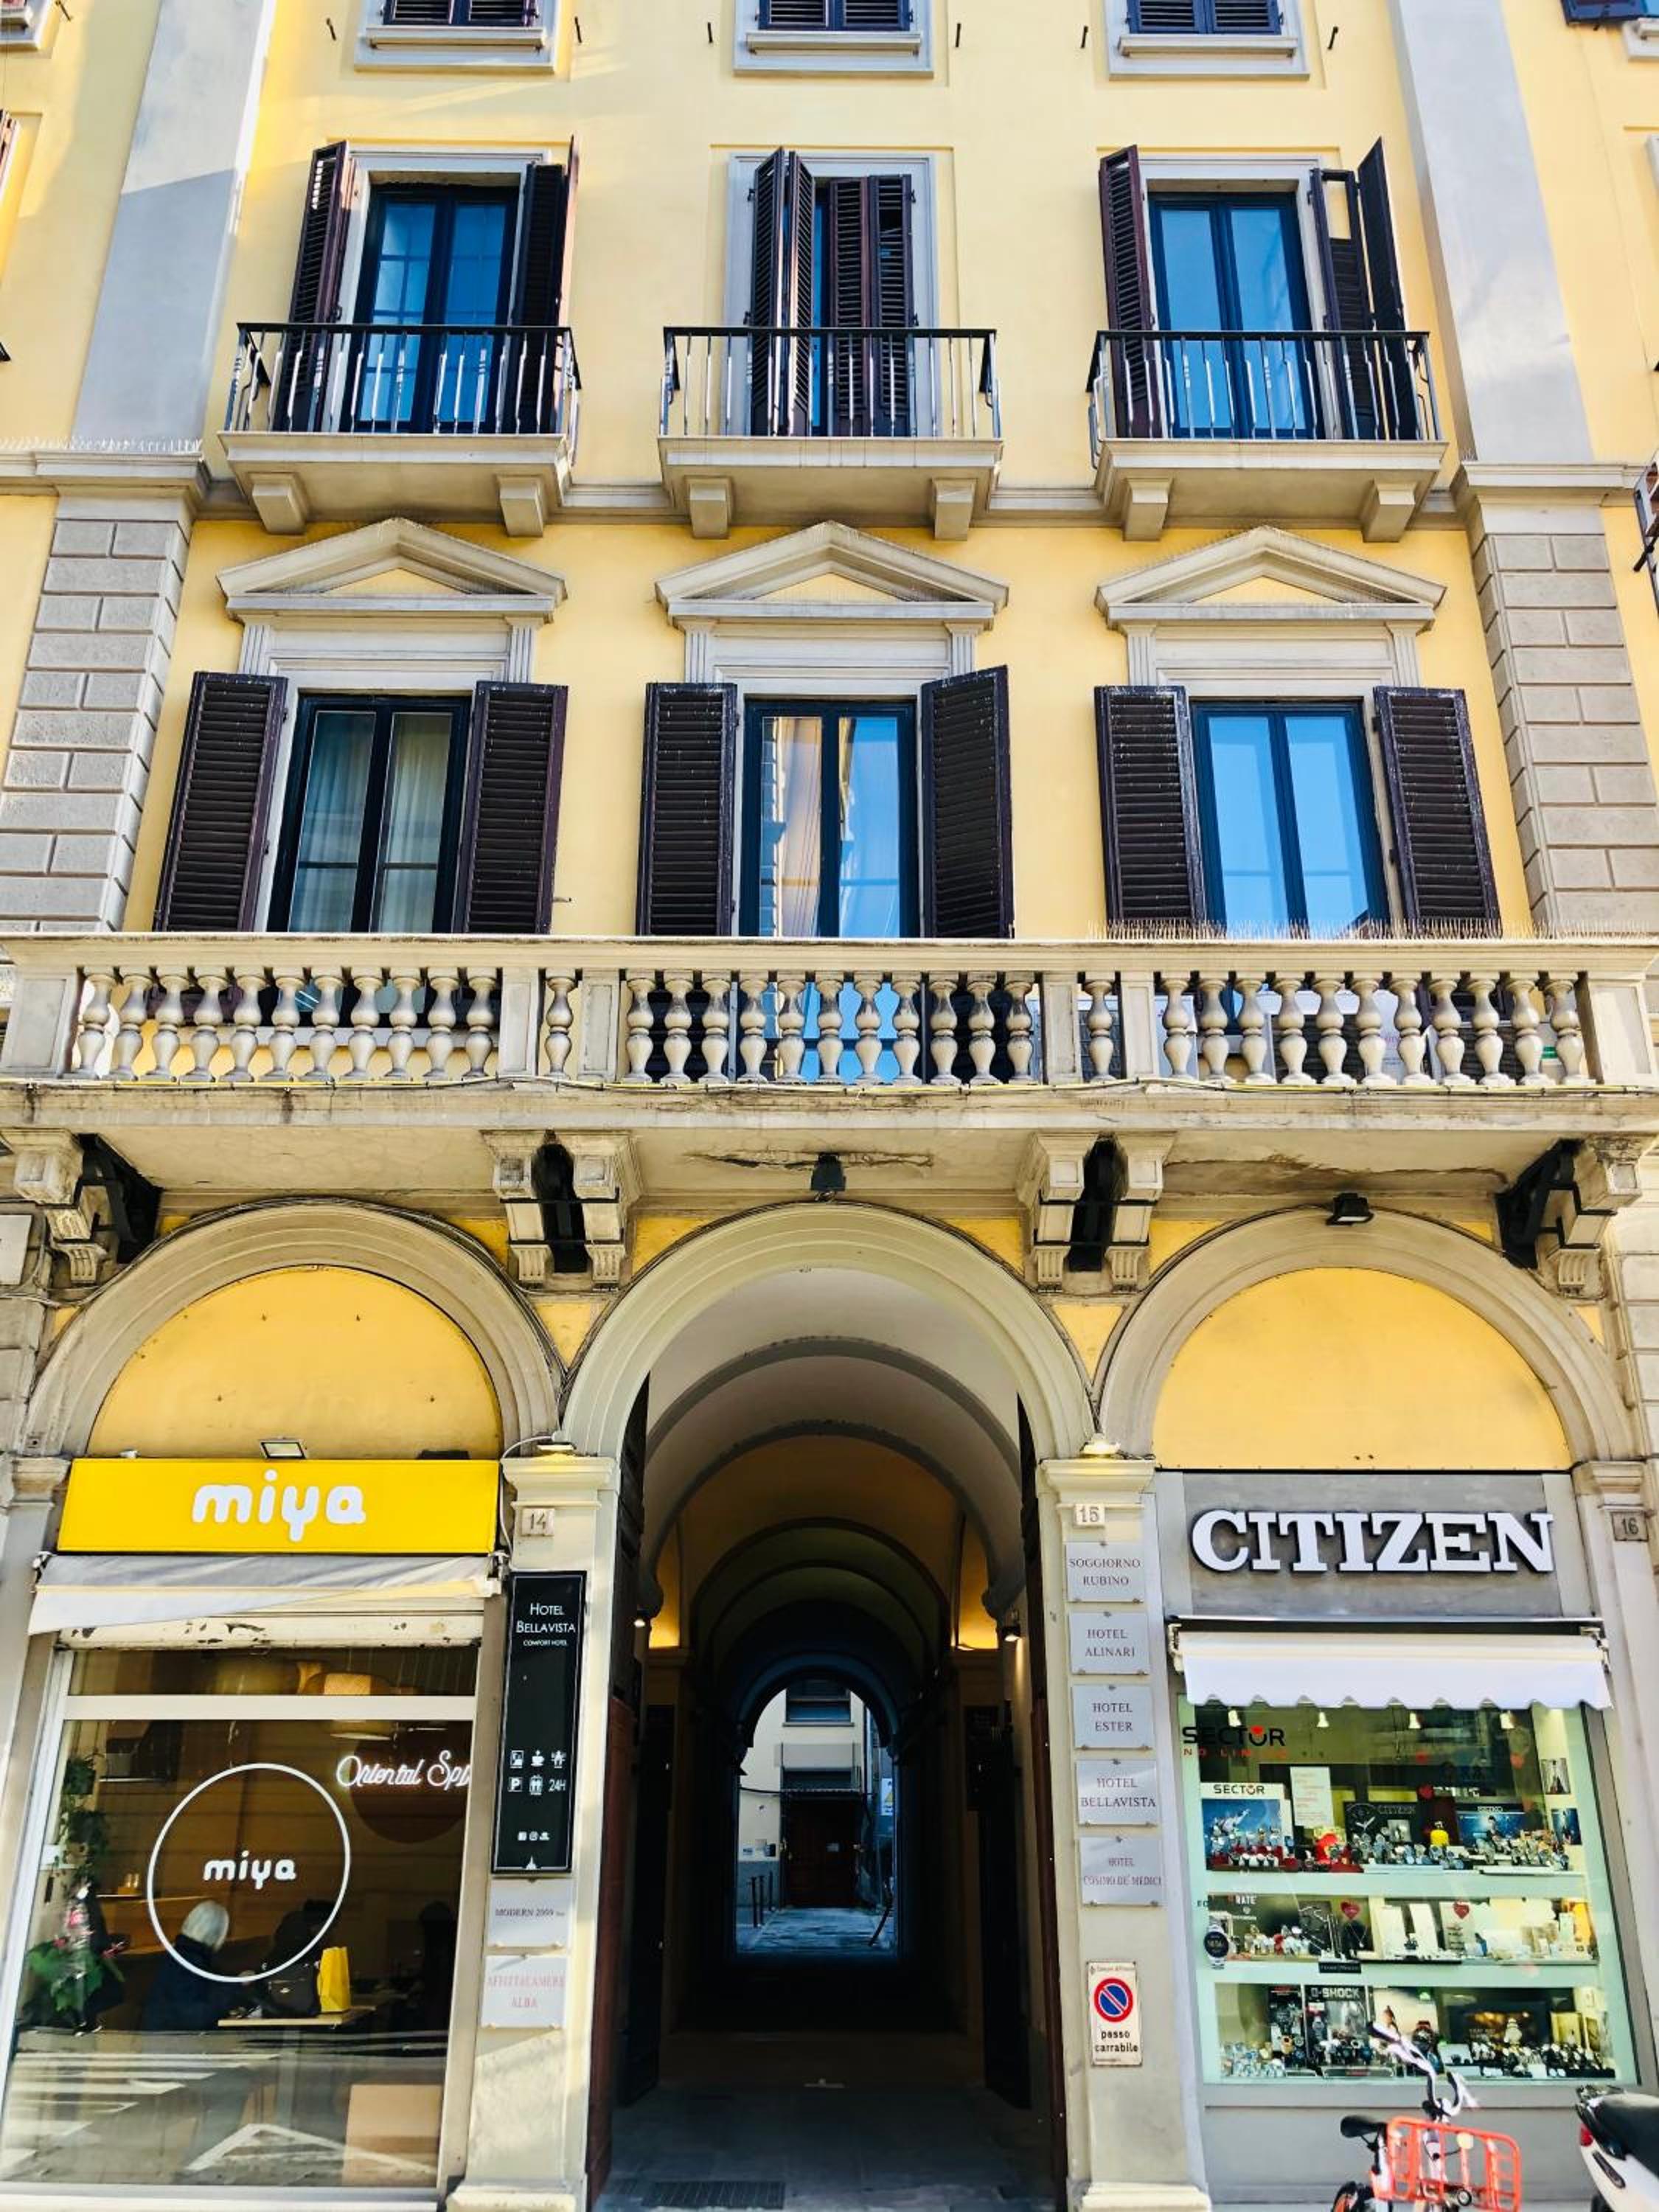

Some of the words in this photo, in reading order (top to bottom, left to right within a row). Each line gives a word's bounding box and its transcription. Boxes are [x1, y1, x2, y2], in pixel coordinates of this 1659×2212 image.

[192, 1469, 366, 1542] miya
[1079, 1506, 1099, 1523] 15
[529, 1512, 546, 1531] 14
[1621, 1517, 1639, 1535] 16
[1191, 1509, 1554, 1573] CITIZEN
[1069, 1558, 1141, 1568] SOGGIORNO
[1083, 1576, 1129, 1586] RUBINO
[1087, 1629, 1128, 1639] HOTEL
[1085, 1646, 1135, 1658] ALINARI
[1092, 1703, 1133, 1714] HOTEL
[1095, 1721, 1133, 1733] ESTER
[1182, 1726, 1286, 1747] SECTOR
[336, 1755, 427, 1787] Oriental
[548, 1778, 567, 1792] 24H
[1096, 1778, 1138, 1789] HOTEL
[1213, 1784, 1265, 1795] SECTOR
[1080, 1797, 1156, 1808] BELLAVISTA
[1107, 1857, 1135, 1867] HOTEL
[203, 1849, 297, 1890] miya
[1101, 2029, 1130, 2039] passo
[1095, 2042, 1139, 2053] carrabile
